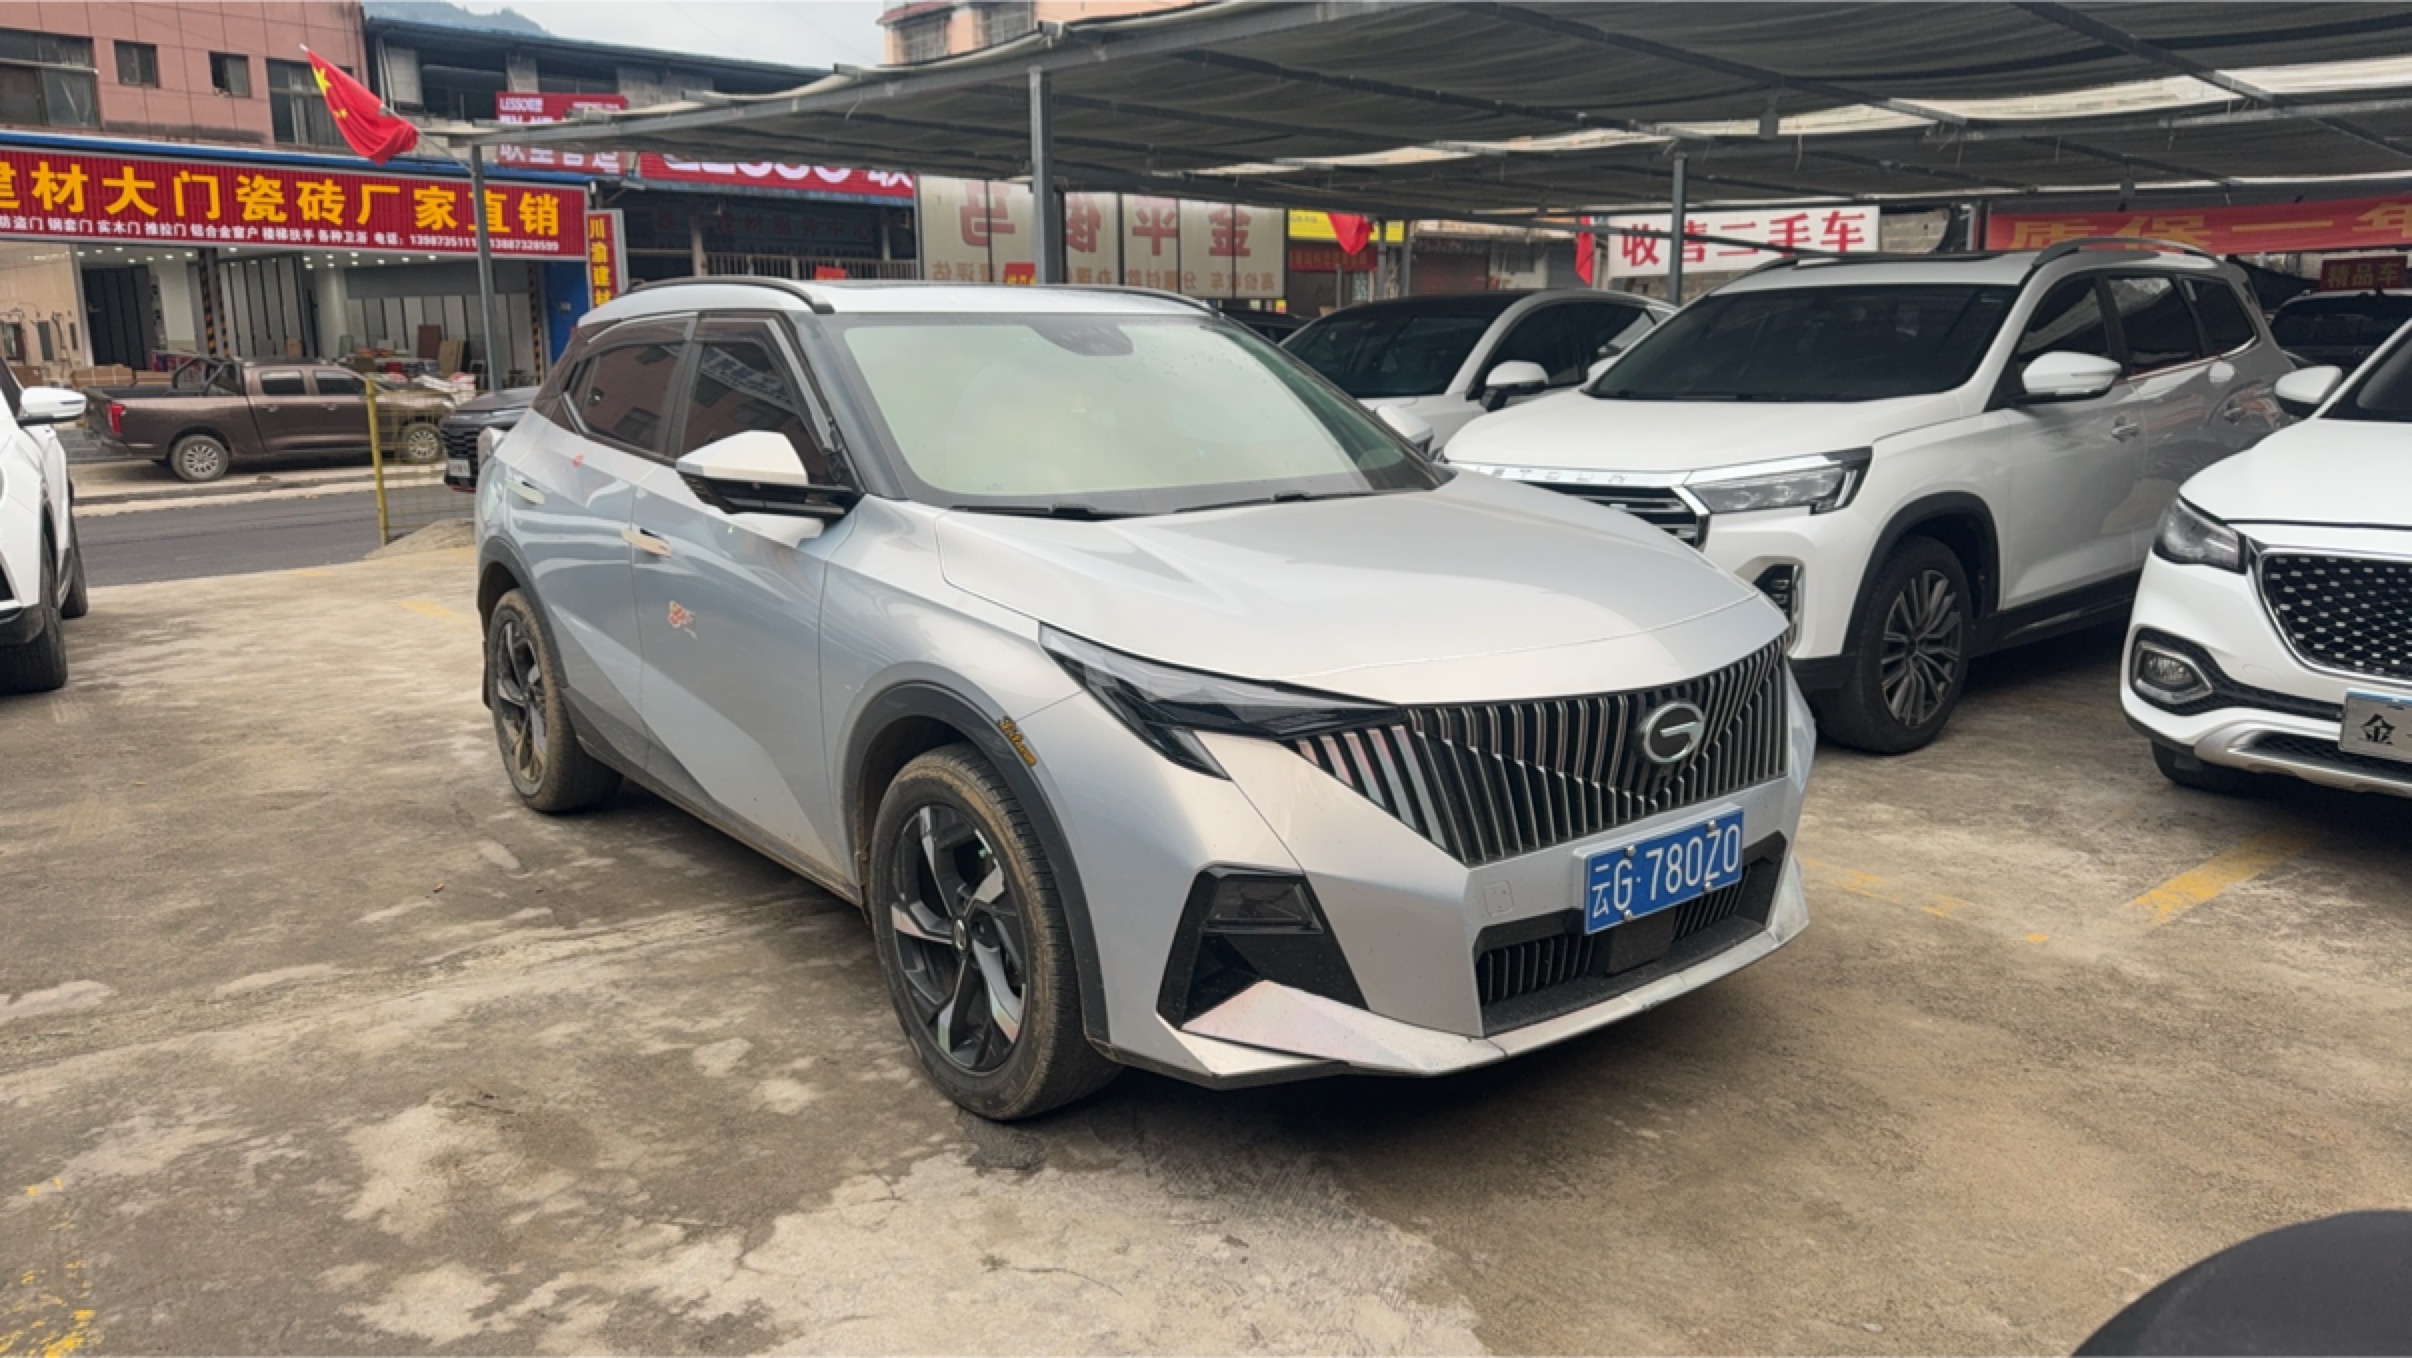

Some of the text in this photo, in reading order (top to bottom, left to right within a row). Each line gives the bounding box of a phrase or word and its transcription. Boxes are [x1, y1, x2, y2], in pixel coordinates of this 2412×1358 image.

[1620, 210, 1866, 268] 收售二手车
